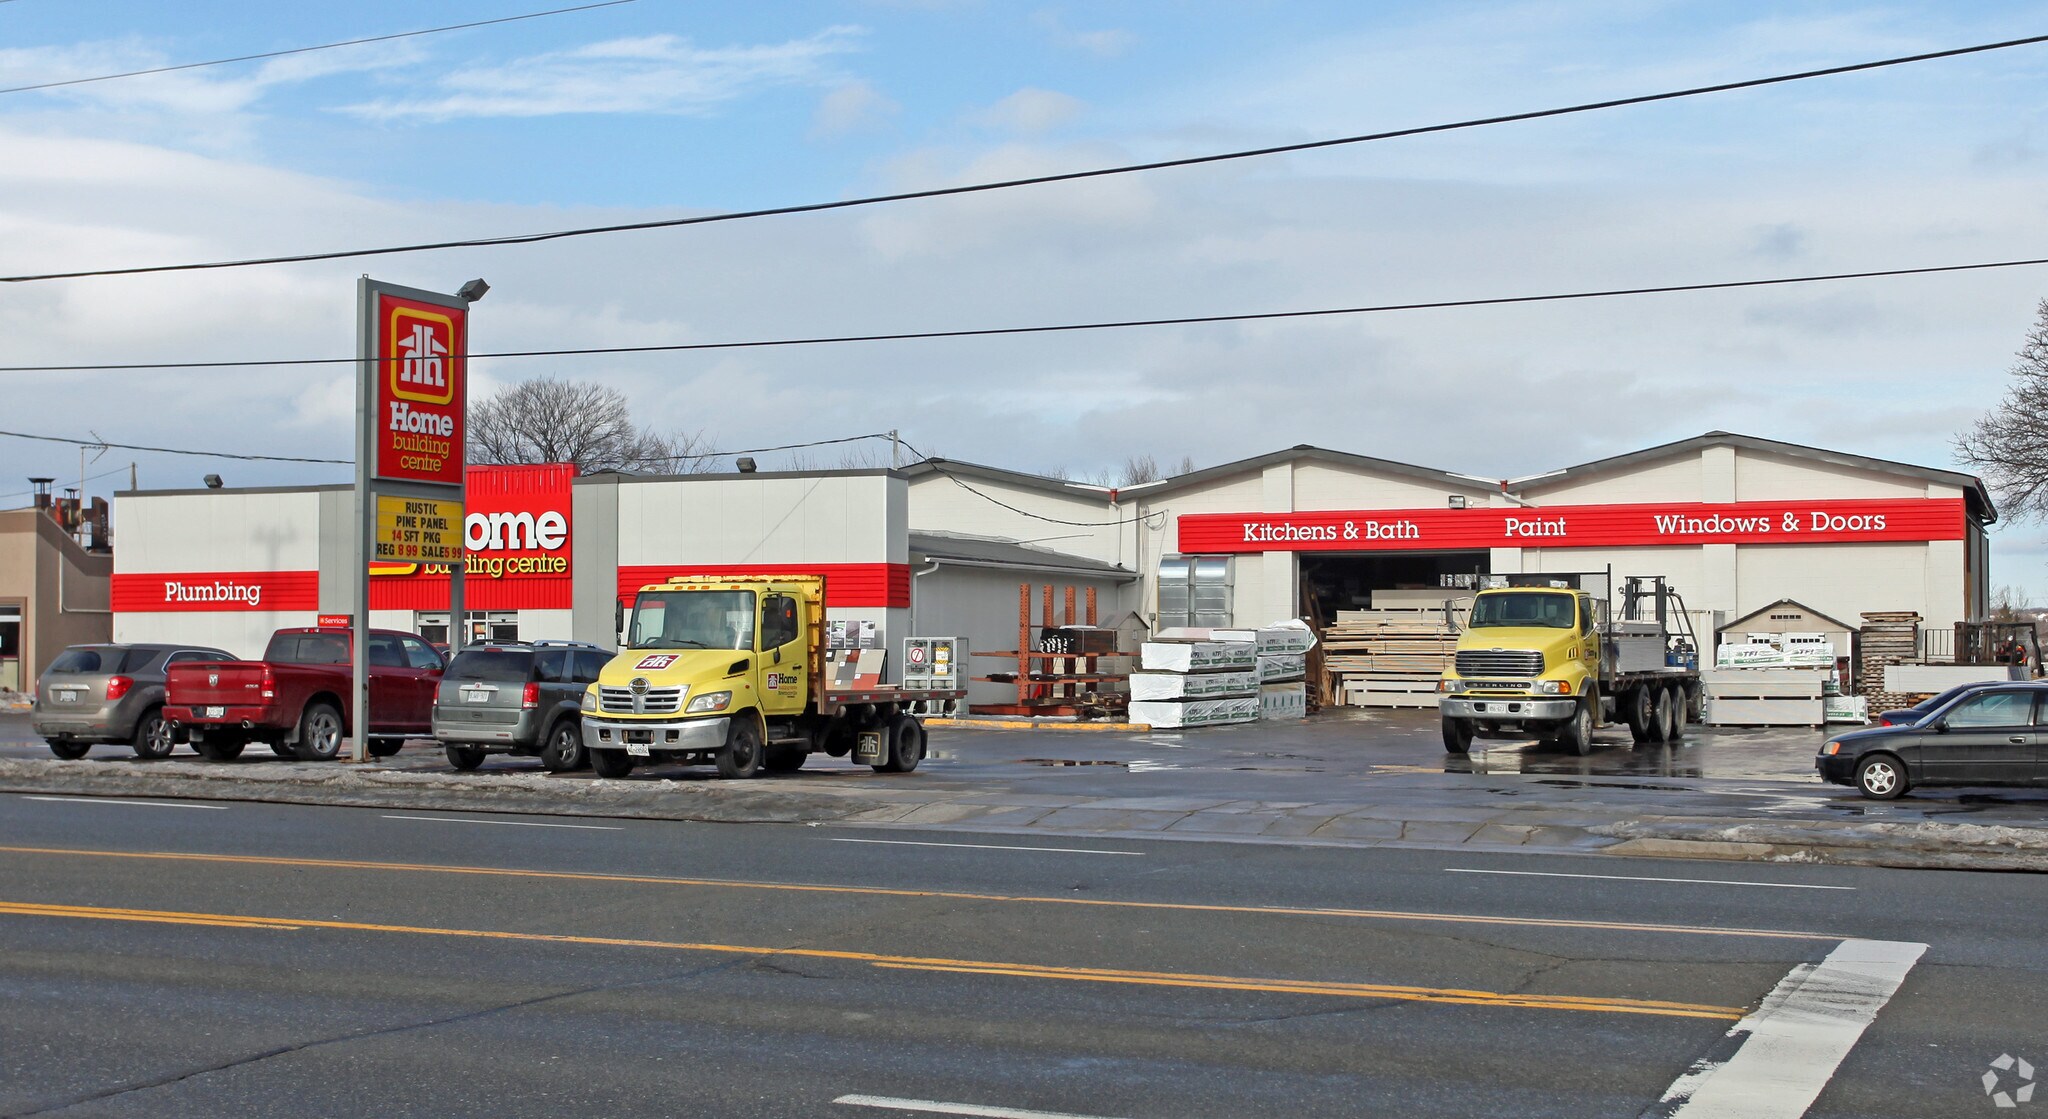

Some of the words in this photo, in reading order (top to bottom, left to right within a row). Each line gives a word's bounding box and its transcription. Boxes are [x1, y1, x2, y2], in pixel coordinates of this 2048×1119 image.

[390, 401, 453, 437] Home
[393, 432, 450, 458] building
[400, 455, 442, 472] centre
[405, 502, 437, 515] RUSTIC
[396, 515, 417, 528] PINE
[421, 517, 448, 530] PANEL
[465, 511, 567, 551] ome
[1243, 523, 1337, 541] Kitchens
[1343, 522, 1359, 539] &
[1366, 520, 1420, 539] Bath
[1505, 517, 1566, 537] Paint
[1654, 514, 1770, 534] Windows
[1781, 512, 1800, 531] &
[1811, 512, 1886, 531] Doors
[392, 530, 402, 541] 14
[404, 530, 420, 542] SFT
[423, 532, 441, 543] PKG
[377, 543, 395, 555] REG
[506, 553, 567, 574] centre
[165, 582, 262, 606] Plumbing
[324, 617, 348, 625] Services
[778, 673, 798, 684] Home
